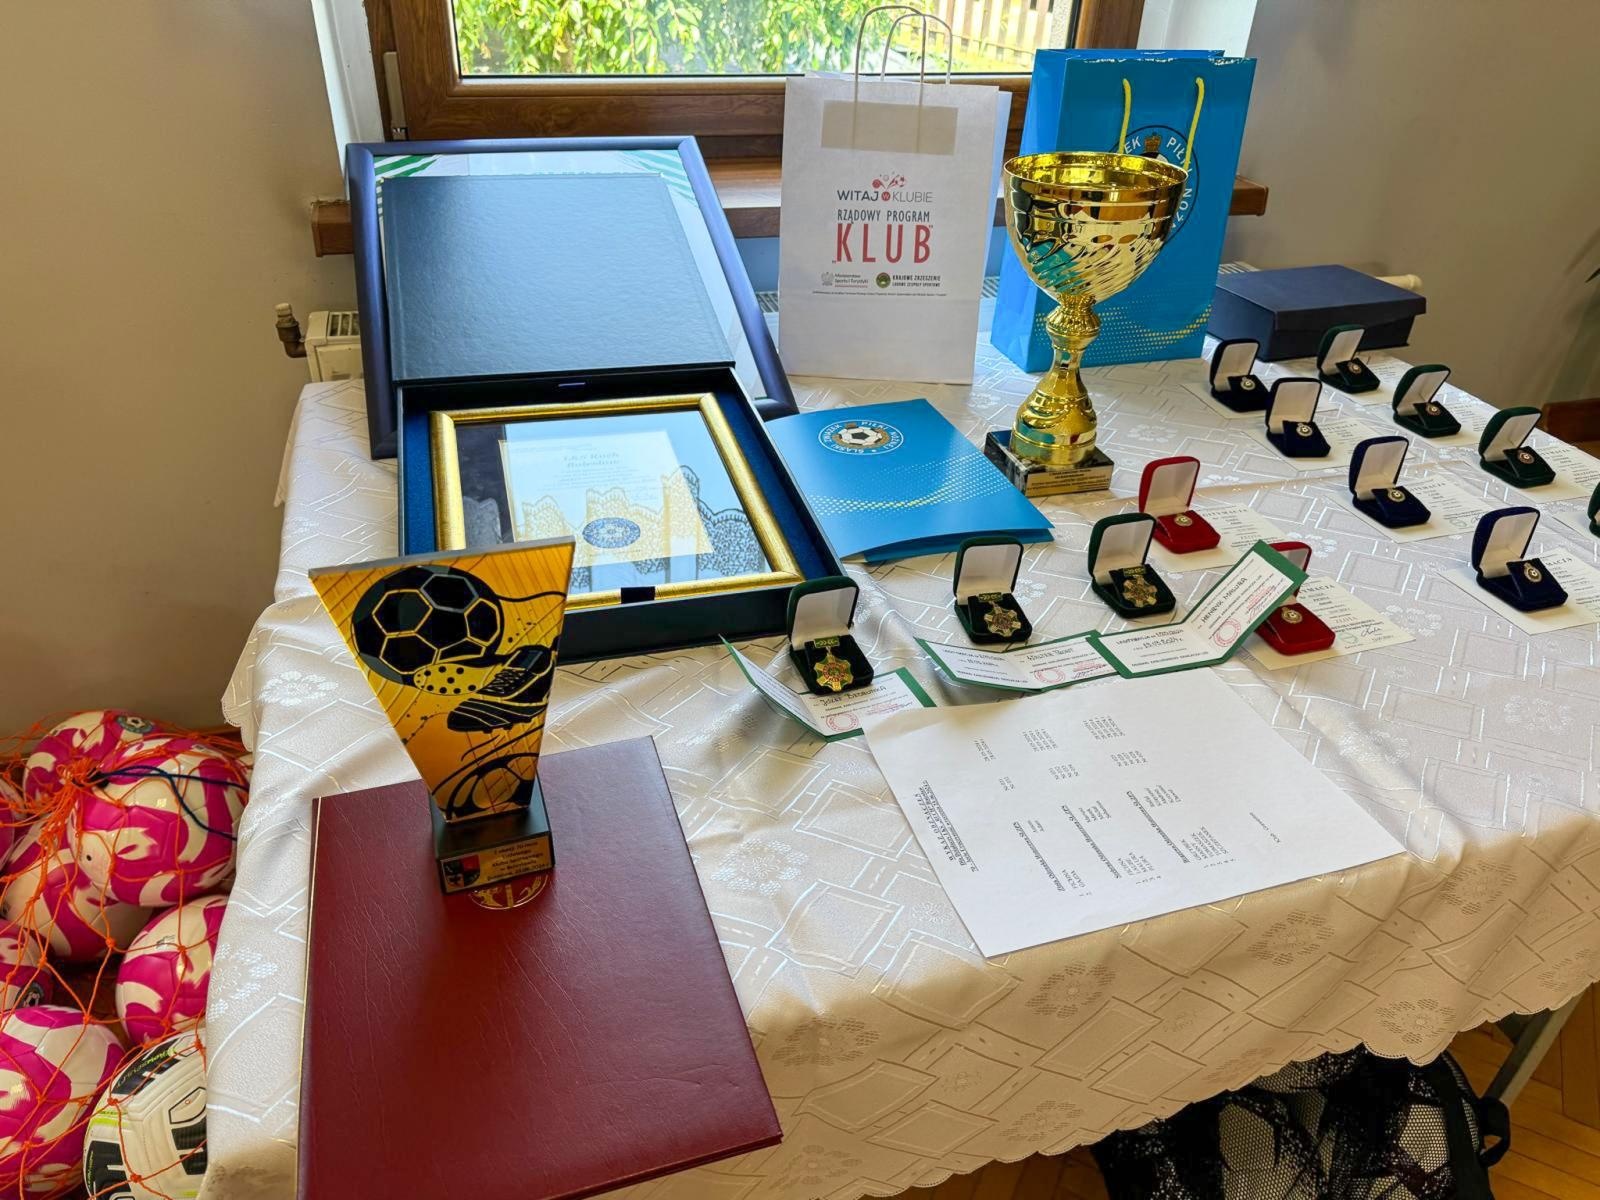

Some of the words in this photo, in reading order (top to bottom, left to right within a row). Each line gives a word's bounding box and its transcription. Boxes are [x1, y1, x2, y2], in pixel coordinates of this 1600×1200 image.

[837, 190, 879, 202] WITAJ
[892, 192, 933, 203] KLUBIE
[837, 209, 881, 224] RZĄDOWY
[886, 211, 930, 223] PROGRAM
